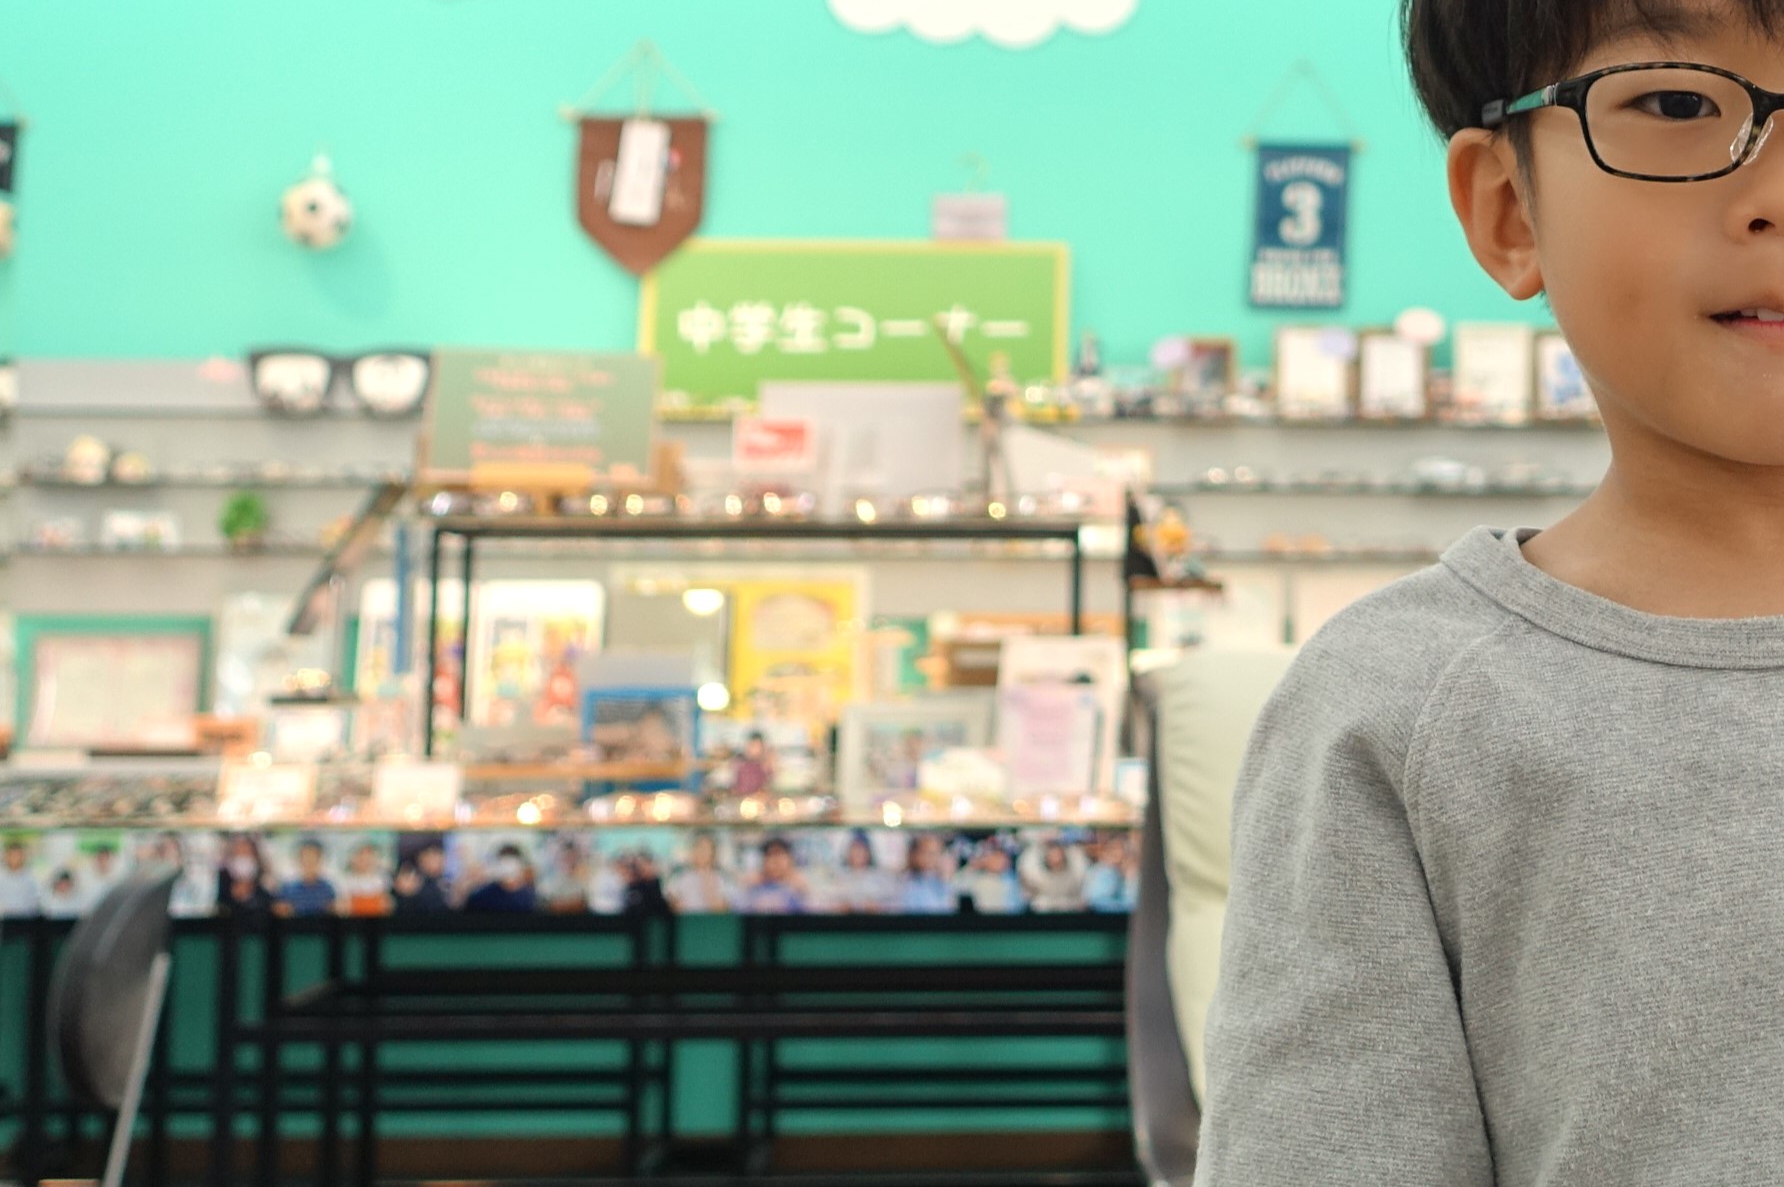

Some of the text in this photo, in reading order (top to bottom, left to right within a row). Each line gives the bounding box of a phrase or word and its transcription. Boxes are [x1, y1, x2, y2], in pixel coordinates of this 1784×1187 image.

[1278, 180, 1323, 247] 3
[676, 300, 1031, 353] 中学生コーナー
